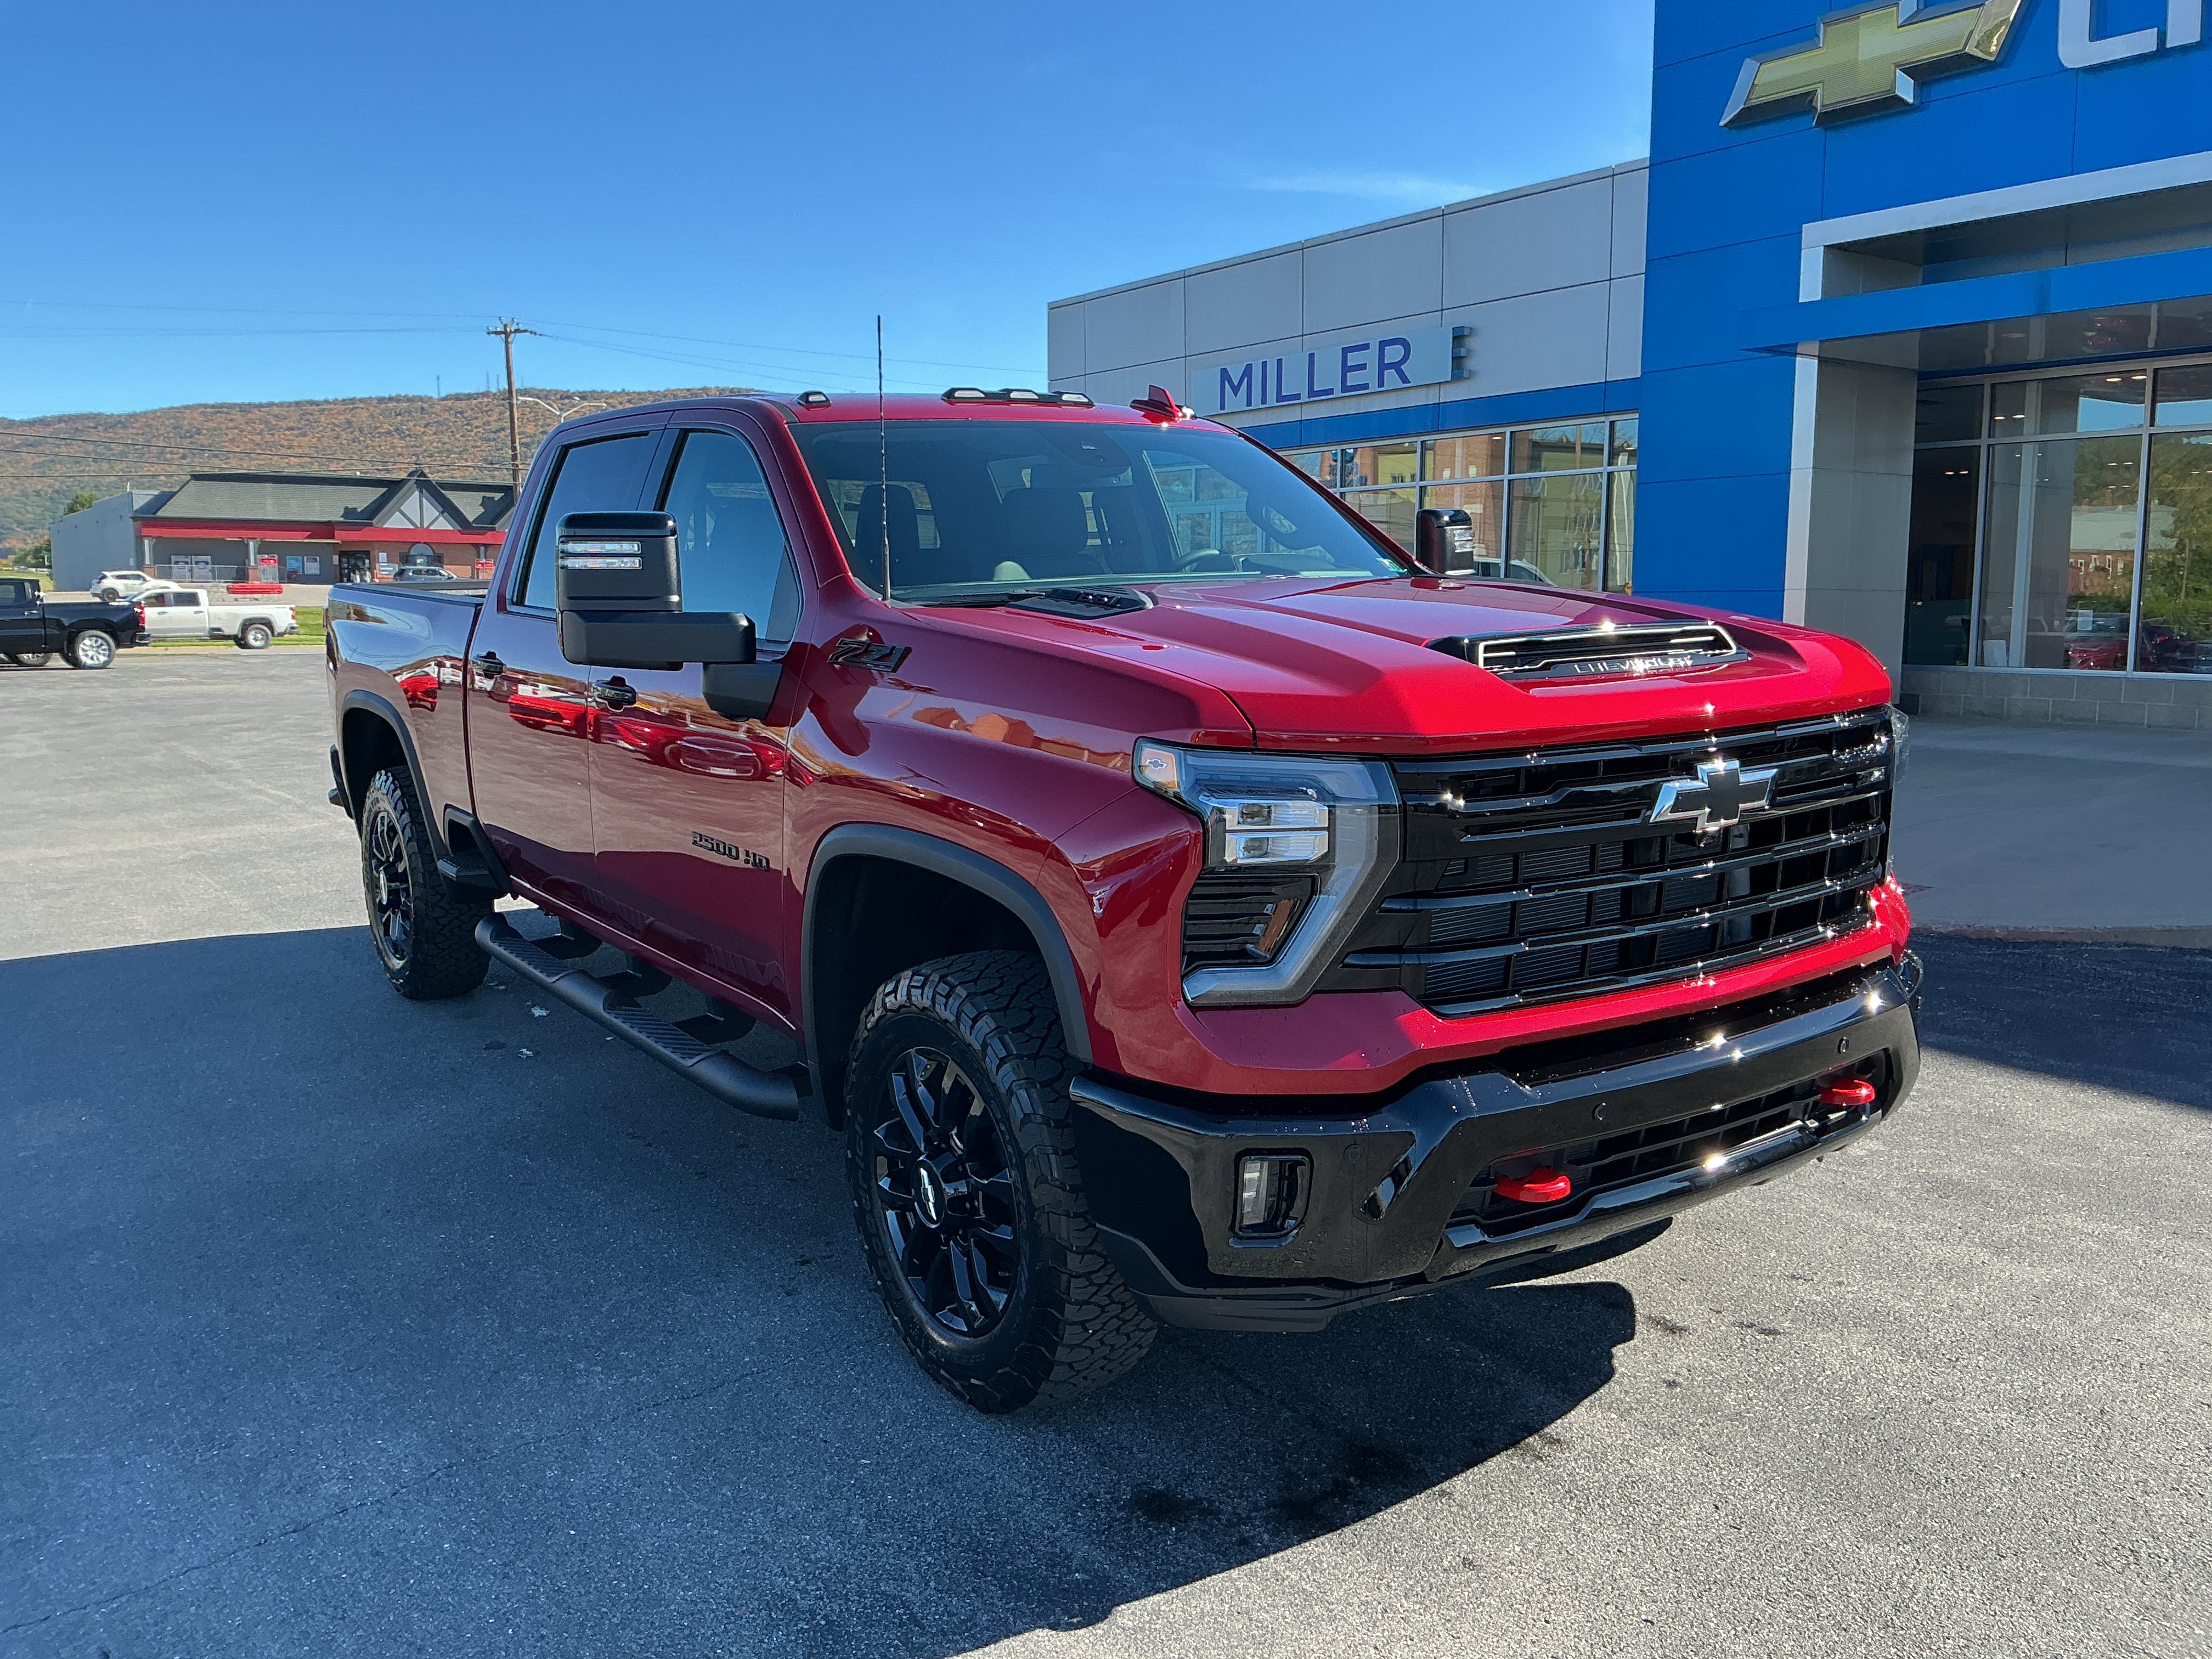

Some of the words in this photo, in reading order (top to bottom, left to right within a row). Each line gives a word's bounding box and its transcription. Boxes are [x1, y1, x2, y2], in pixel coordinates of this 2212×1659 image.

[1219, 336, 1412, 411] MILLER
[691, 830, 740, 860] 2500
[743, 849, 770, 872] HD
